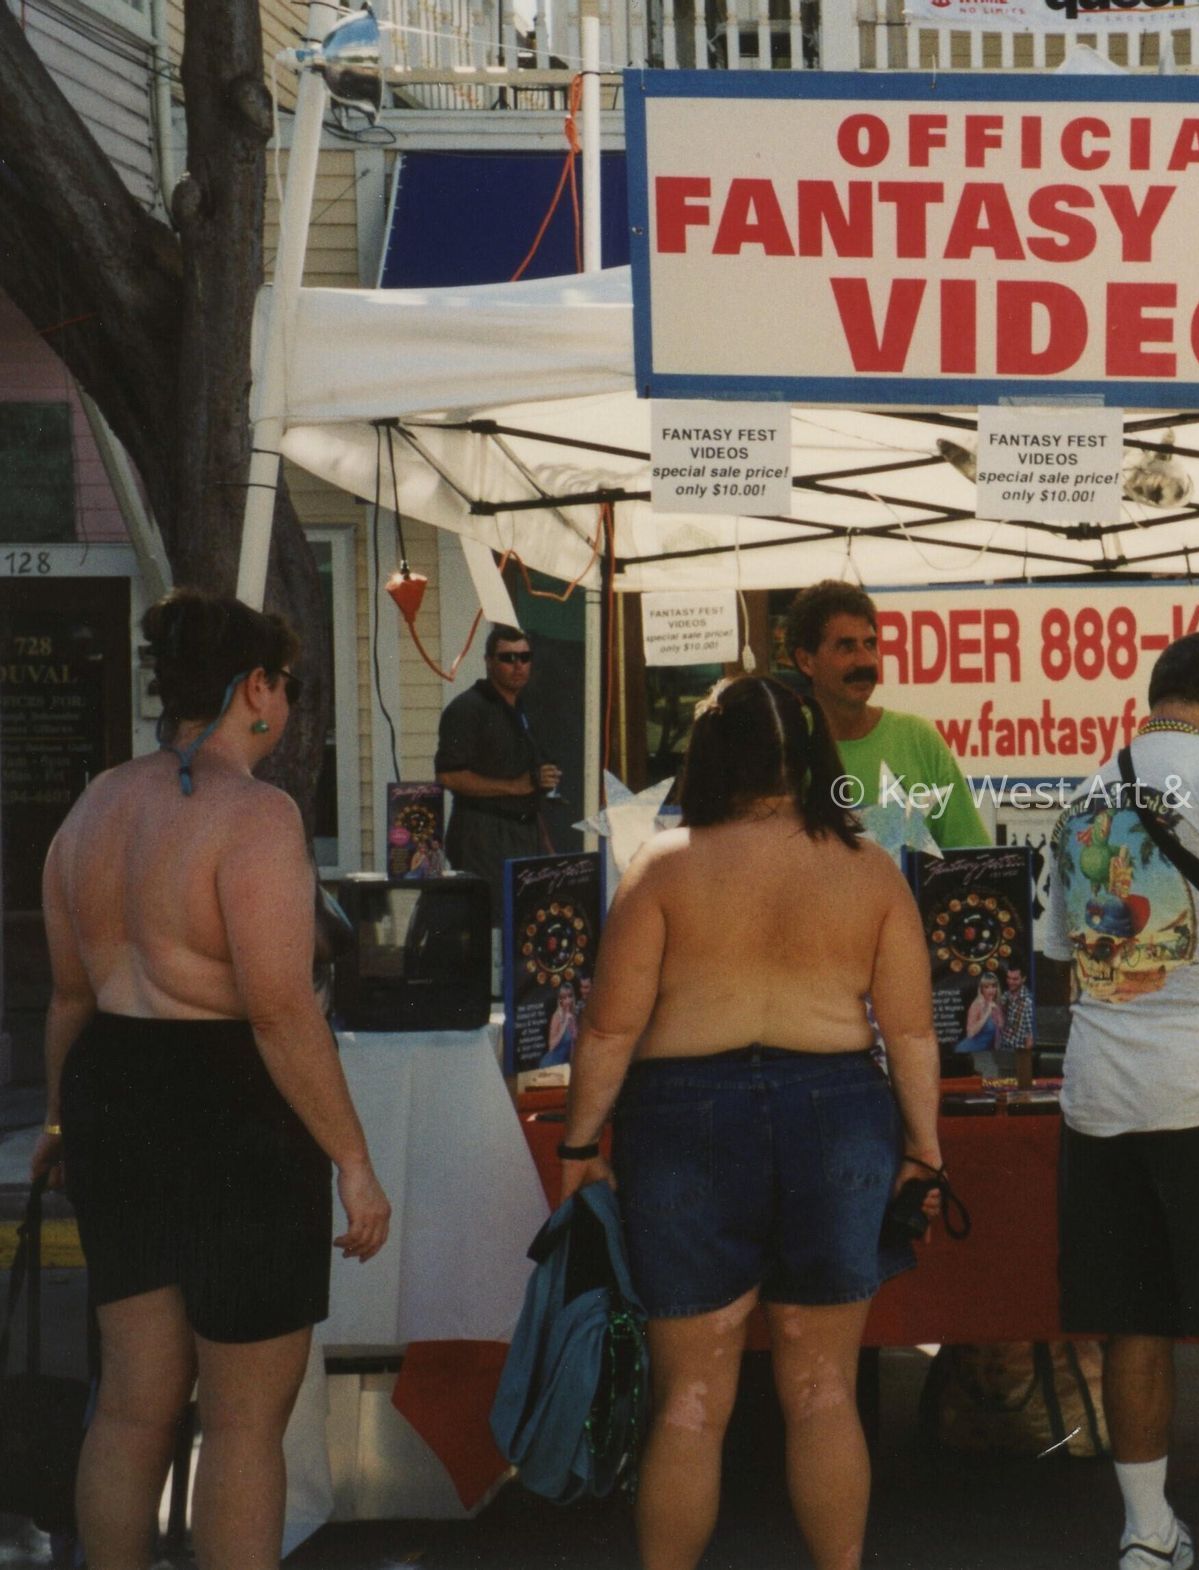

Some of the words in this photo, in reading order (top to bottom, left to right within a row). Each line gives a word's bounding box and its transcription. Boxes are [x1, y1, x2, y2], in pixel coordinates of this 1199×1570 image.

[656, 176, 1176, 263] FANTASY
[662, 428, 732, 441] FANTASY
[738, 429, 777, 441] FEST
[989, 434, 1062, 447] FANTASY
[1067, 435, 1107, 447] FEST
[690, 447, 749, 459] VIDEOS
[1018, 453, 1078, 465] VIDEOS
[652, 465, 706, 480] special
[710, 466, 741, 477] sale
[745, 467, 789, 480] price!
[978, 471, 1033, 484] special
[1038, 472, 1070, 484] sale
[1073, 472, 1119, 486] price!
[675, 484, 708, 498] only
[712, 483, 766, 496] $10.00!
[1001, 489, 1035, 504] only
[1040, 489, 1096, 502] $10.00!
[876, 608, 1021, 685] RDER
